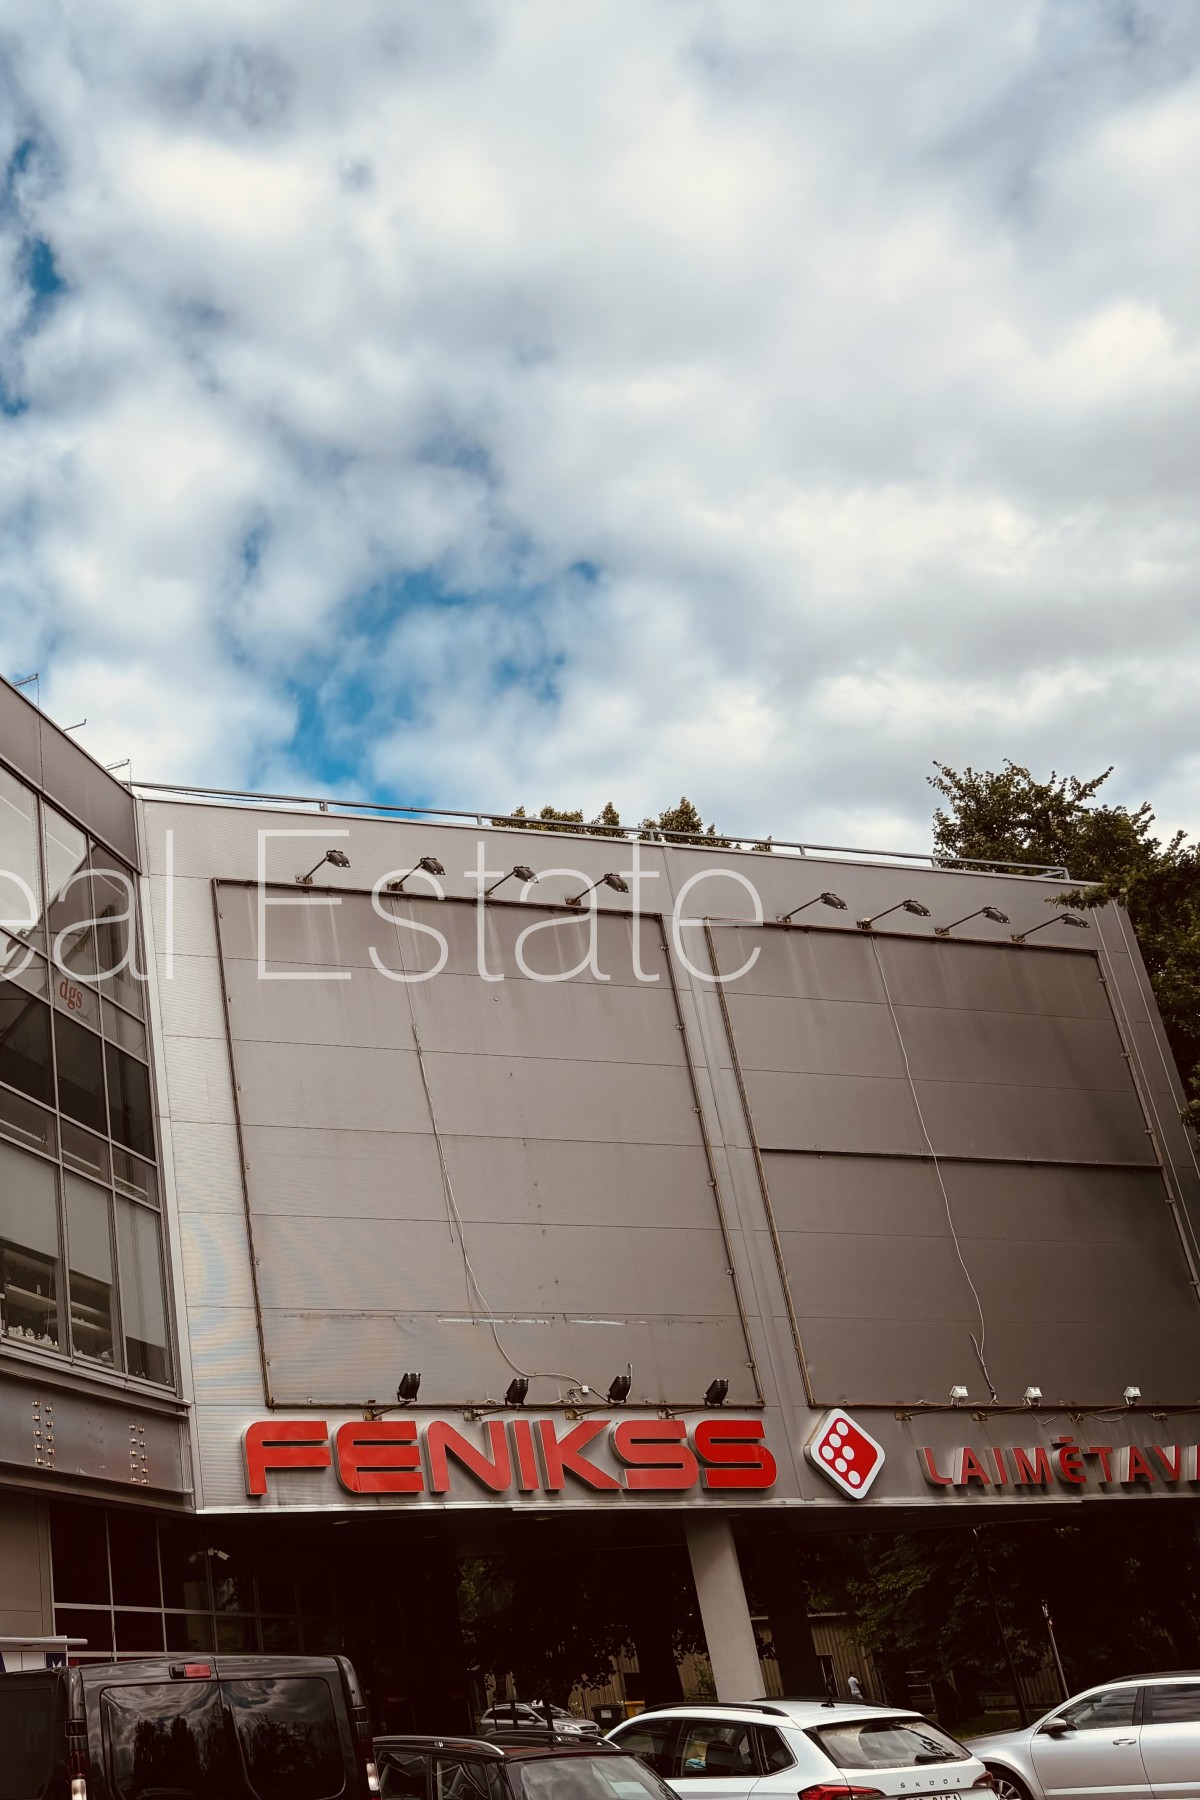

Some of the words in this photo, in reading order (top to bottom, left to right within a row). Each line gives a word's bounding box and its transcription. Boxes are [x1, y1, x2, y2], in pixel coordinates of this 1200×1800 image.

[60, 977, 82, 1010] dgs
[243, 1419, 777, 1496] FENIKSS
[918, 1436, 1200, 1486] LAIMĒTAV
[899, 1776, 961, 1789] ŠKODA
